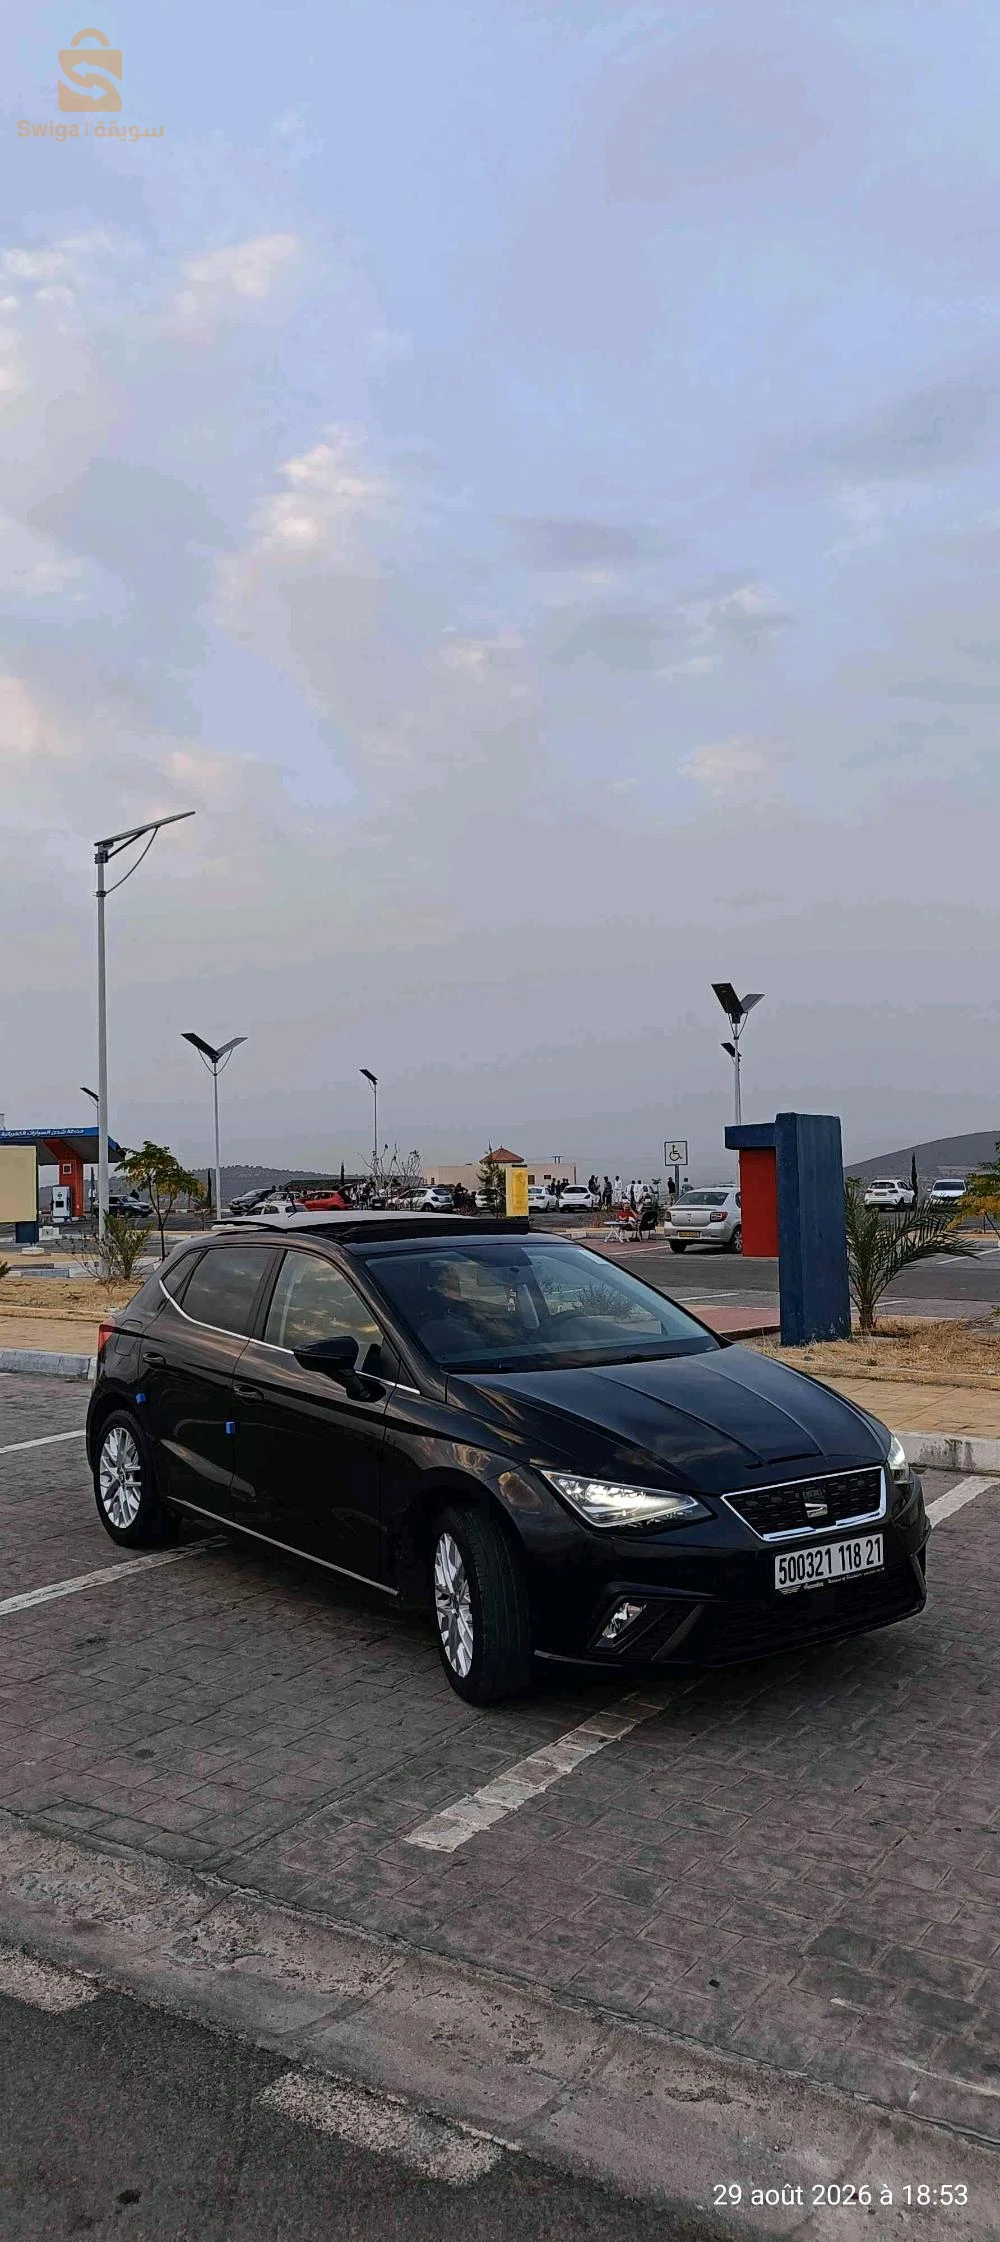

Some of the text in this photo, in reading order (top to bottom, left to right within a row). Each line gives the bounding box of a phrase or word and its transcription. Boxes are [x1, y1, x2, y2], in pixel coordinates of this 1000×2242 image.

[779, 1547, 832, 1585] 500321
[838, 1542, 861, 1571] 118
[866, 1537, 881, 1566] 21
